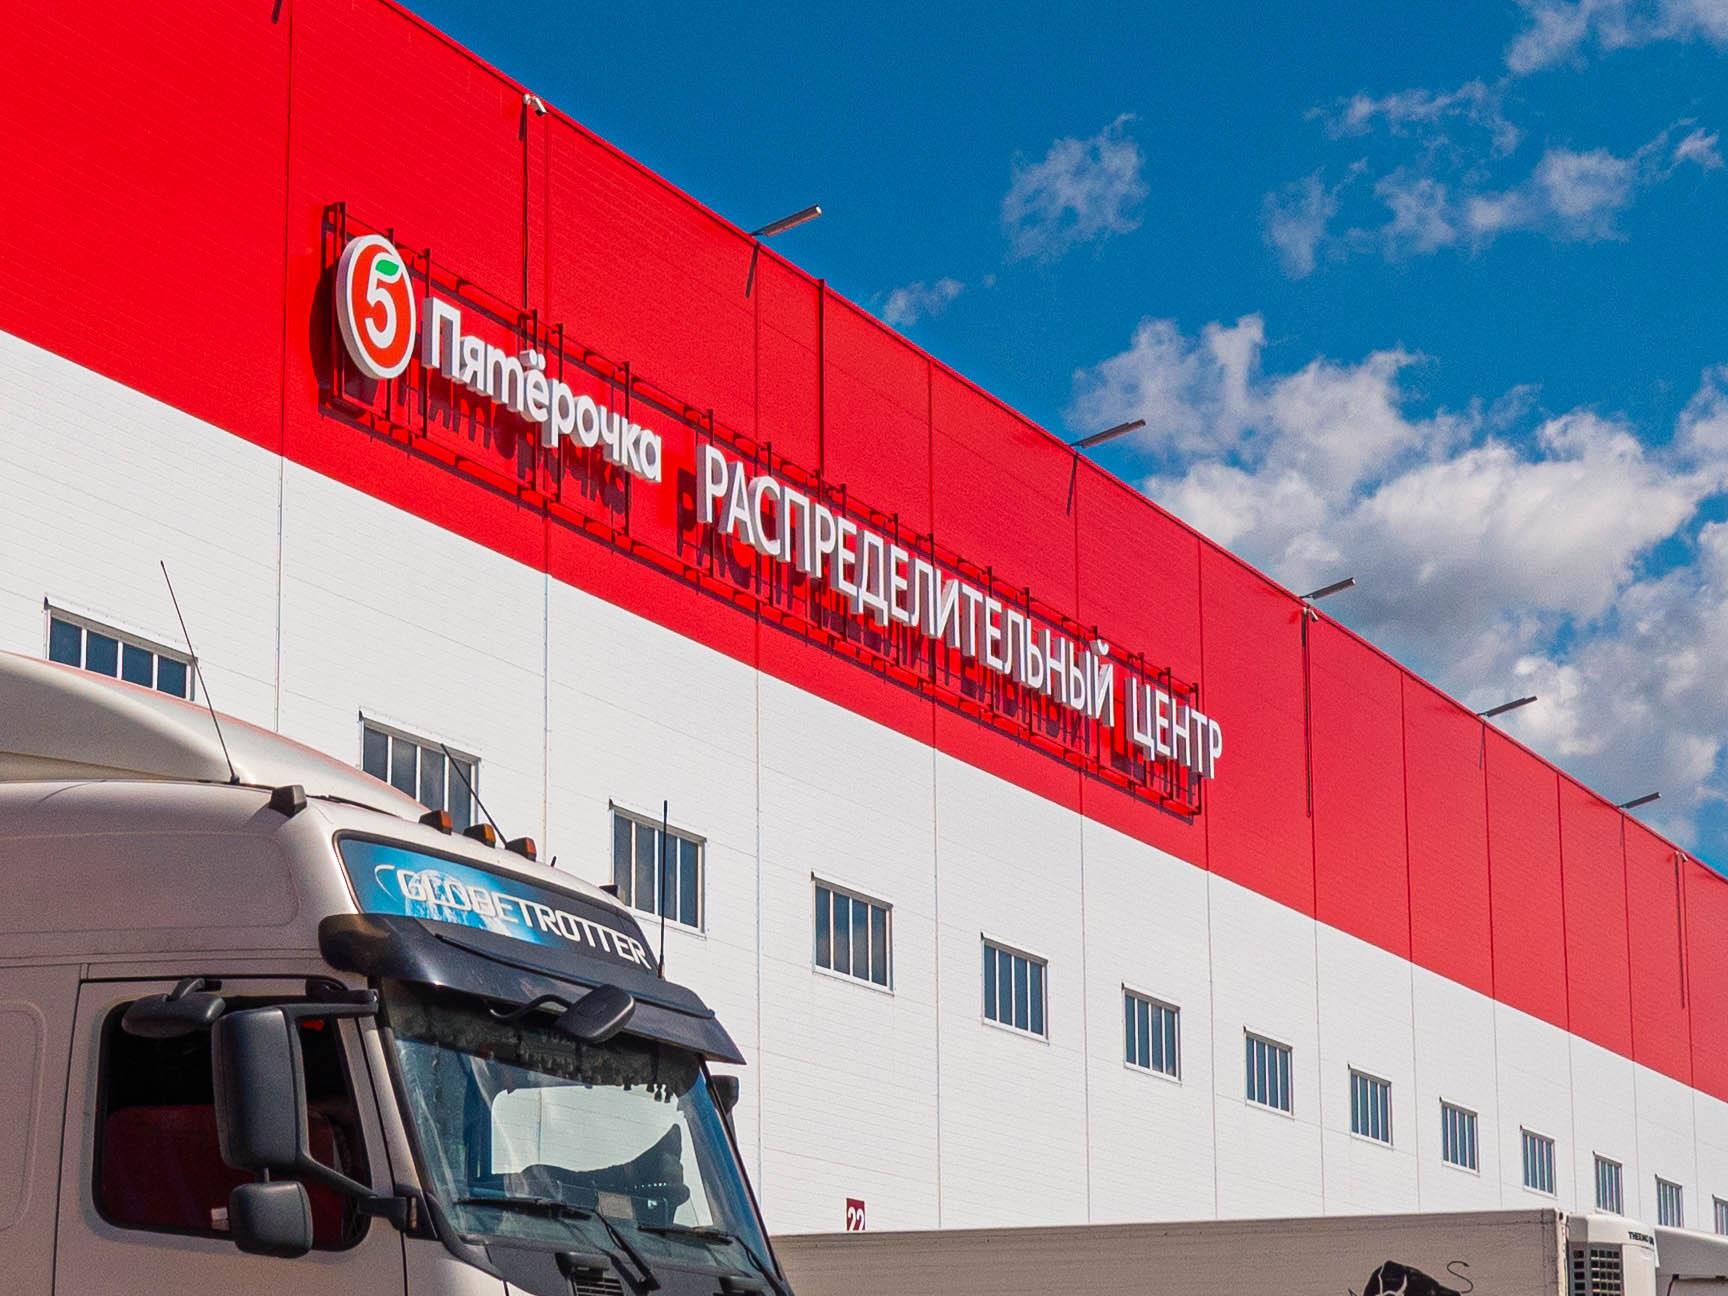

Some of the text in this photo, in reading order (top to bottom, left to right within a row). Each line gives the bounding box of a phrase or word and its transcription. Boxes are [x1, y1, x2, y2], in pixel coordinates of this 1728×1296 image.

[422, 296, 662, 484] Пятёрочка
[696, 444, 1223, 780] РАСПРЕДЕЛИТЕЛЬНЫЙ ЦЕНТР
[394, 868, 653, 971] GLOBETROTTER
